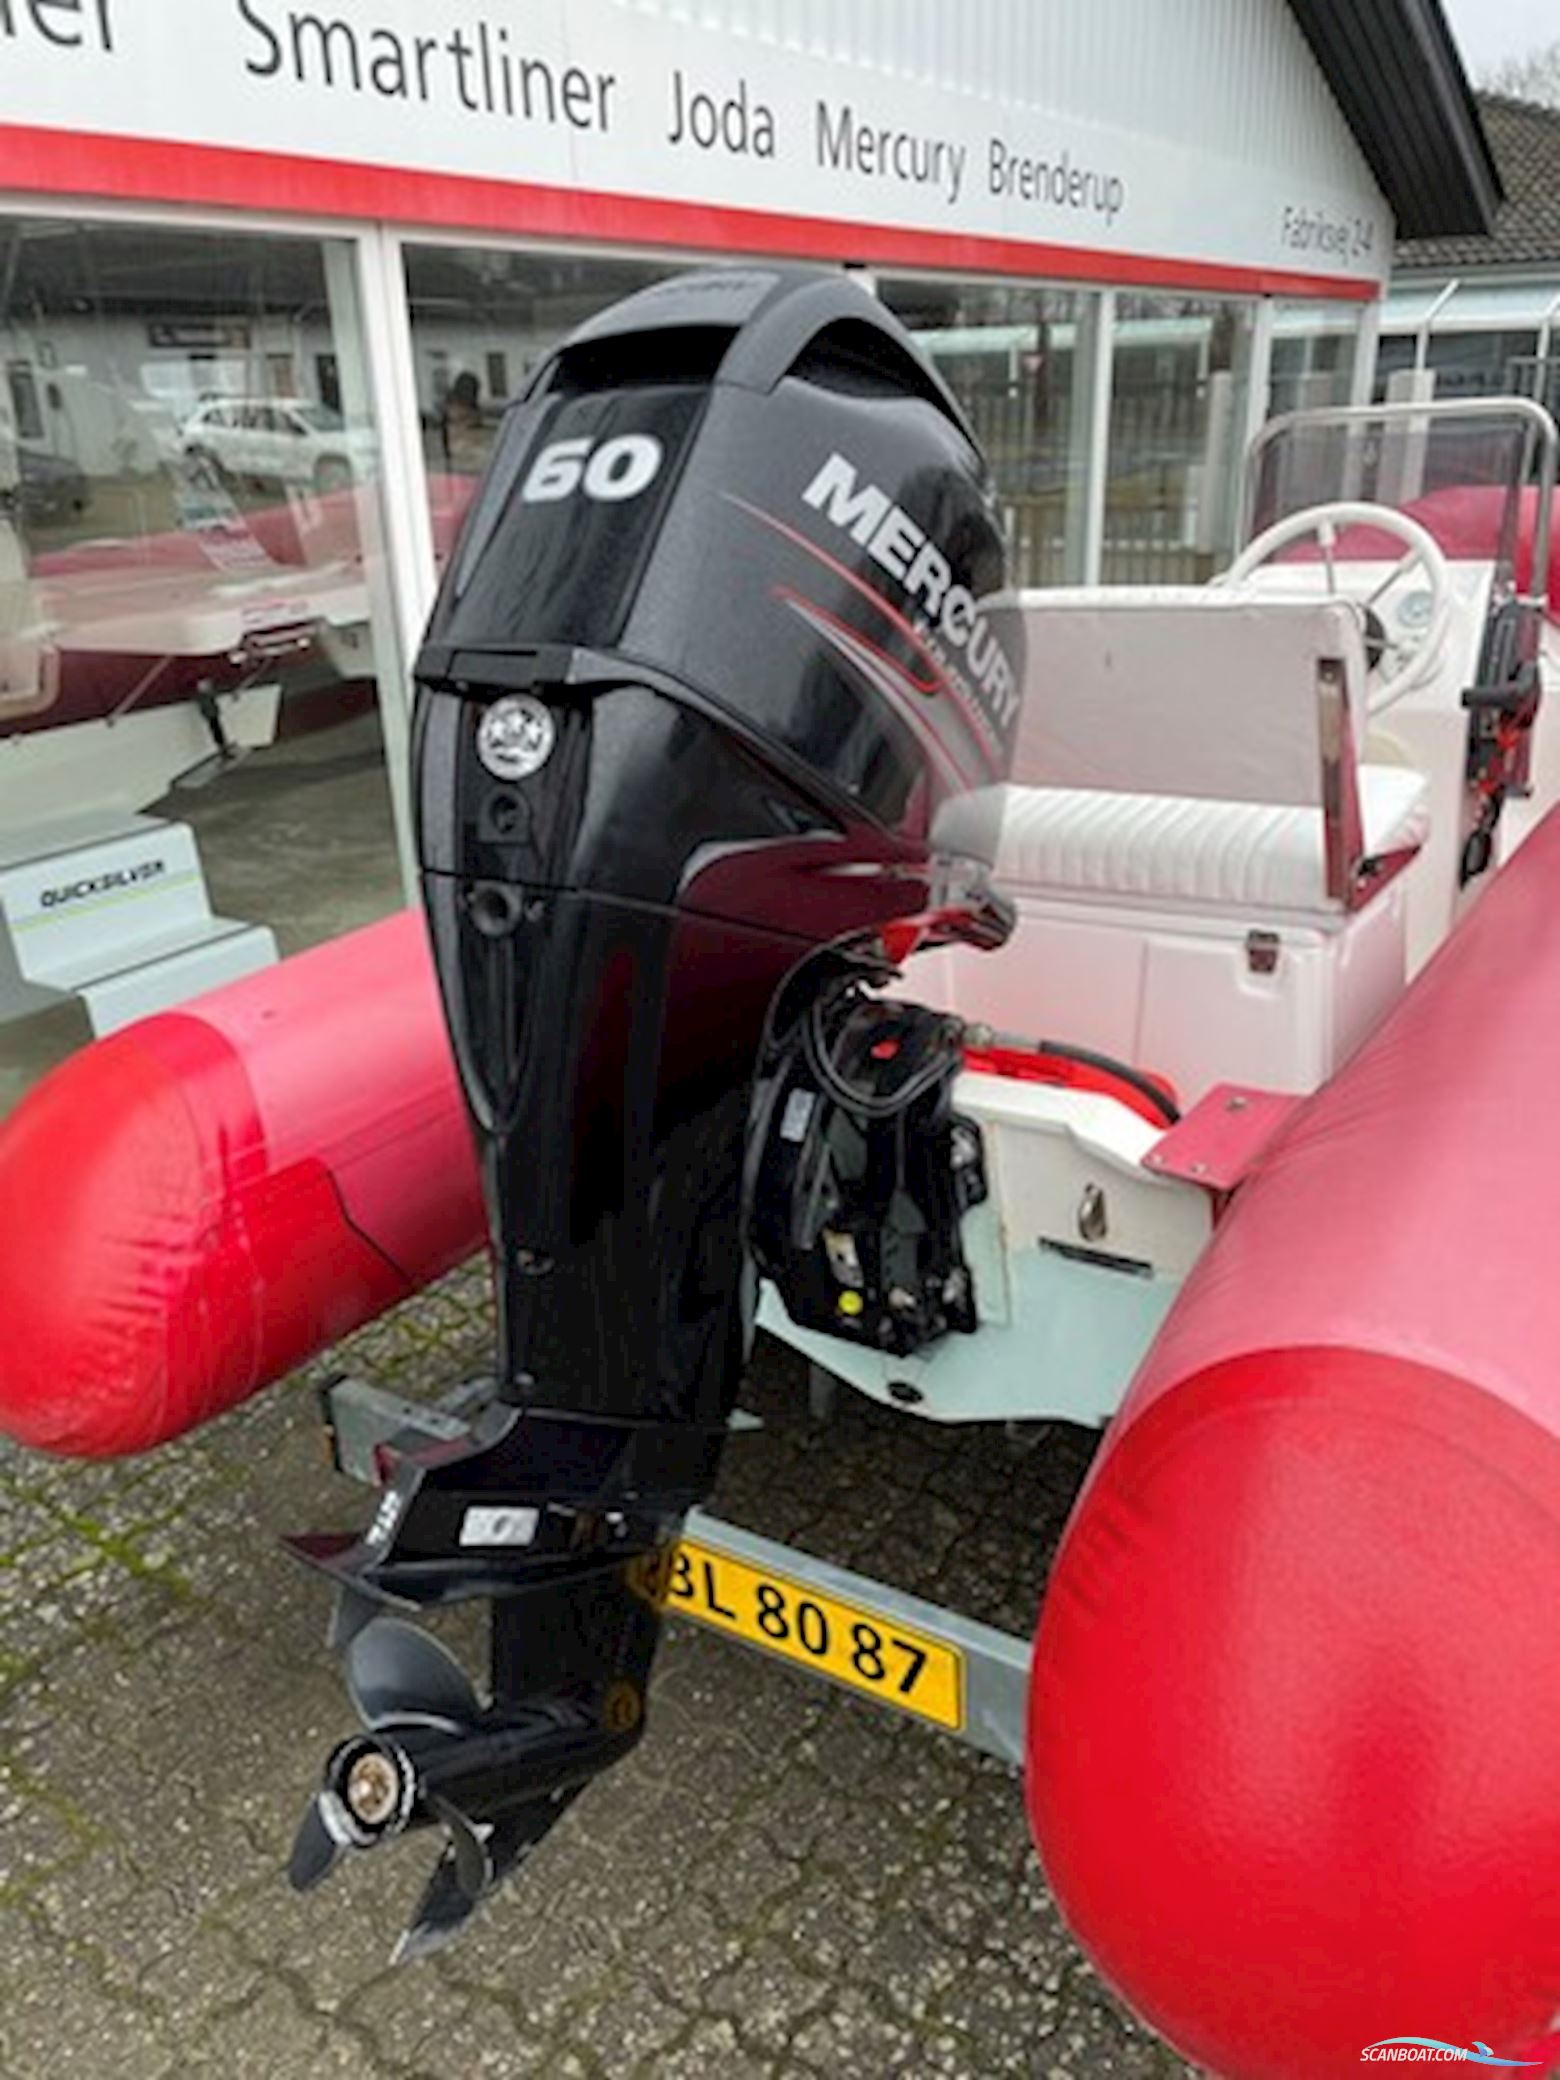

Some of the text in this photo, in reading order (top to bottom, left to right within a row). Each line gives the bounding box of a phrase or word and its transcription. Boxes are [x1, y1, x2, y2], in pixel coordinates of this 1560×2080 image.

[238, 0, 617, 132] Smartliner
[668, 71, 776, 158] Joda
[816, 101, 966, 203] Mercury
[988, 138, 1124, 225] Brenderup
[522, 433, 664, 501] 60
[802, 453, 1017, 727] MERCURY
[756, 1583, 829, 1656] 80
[852, 1623, 927, 1693] 87
